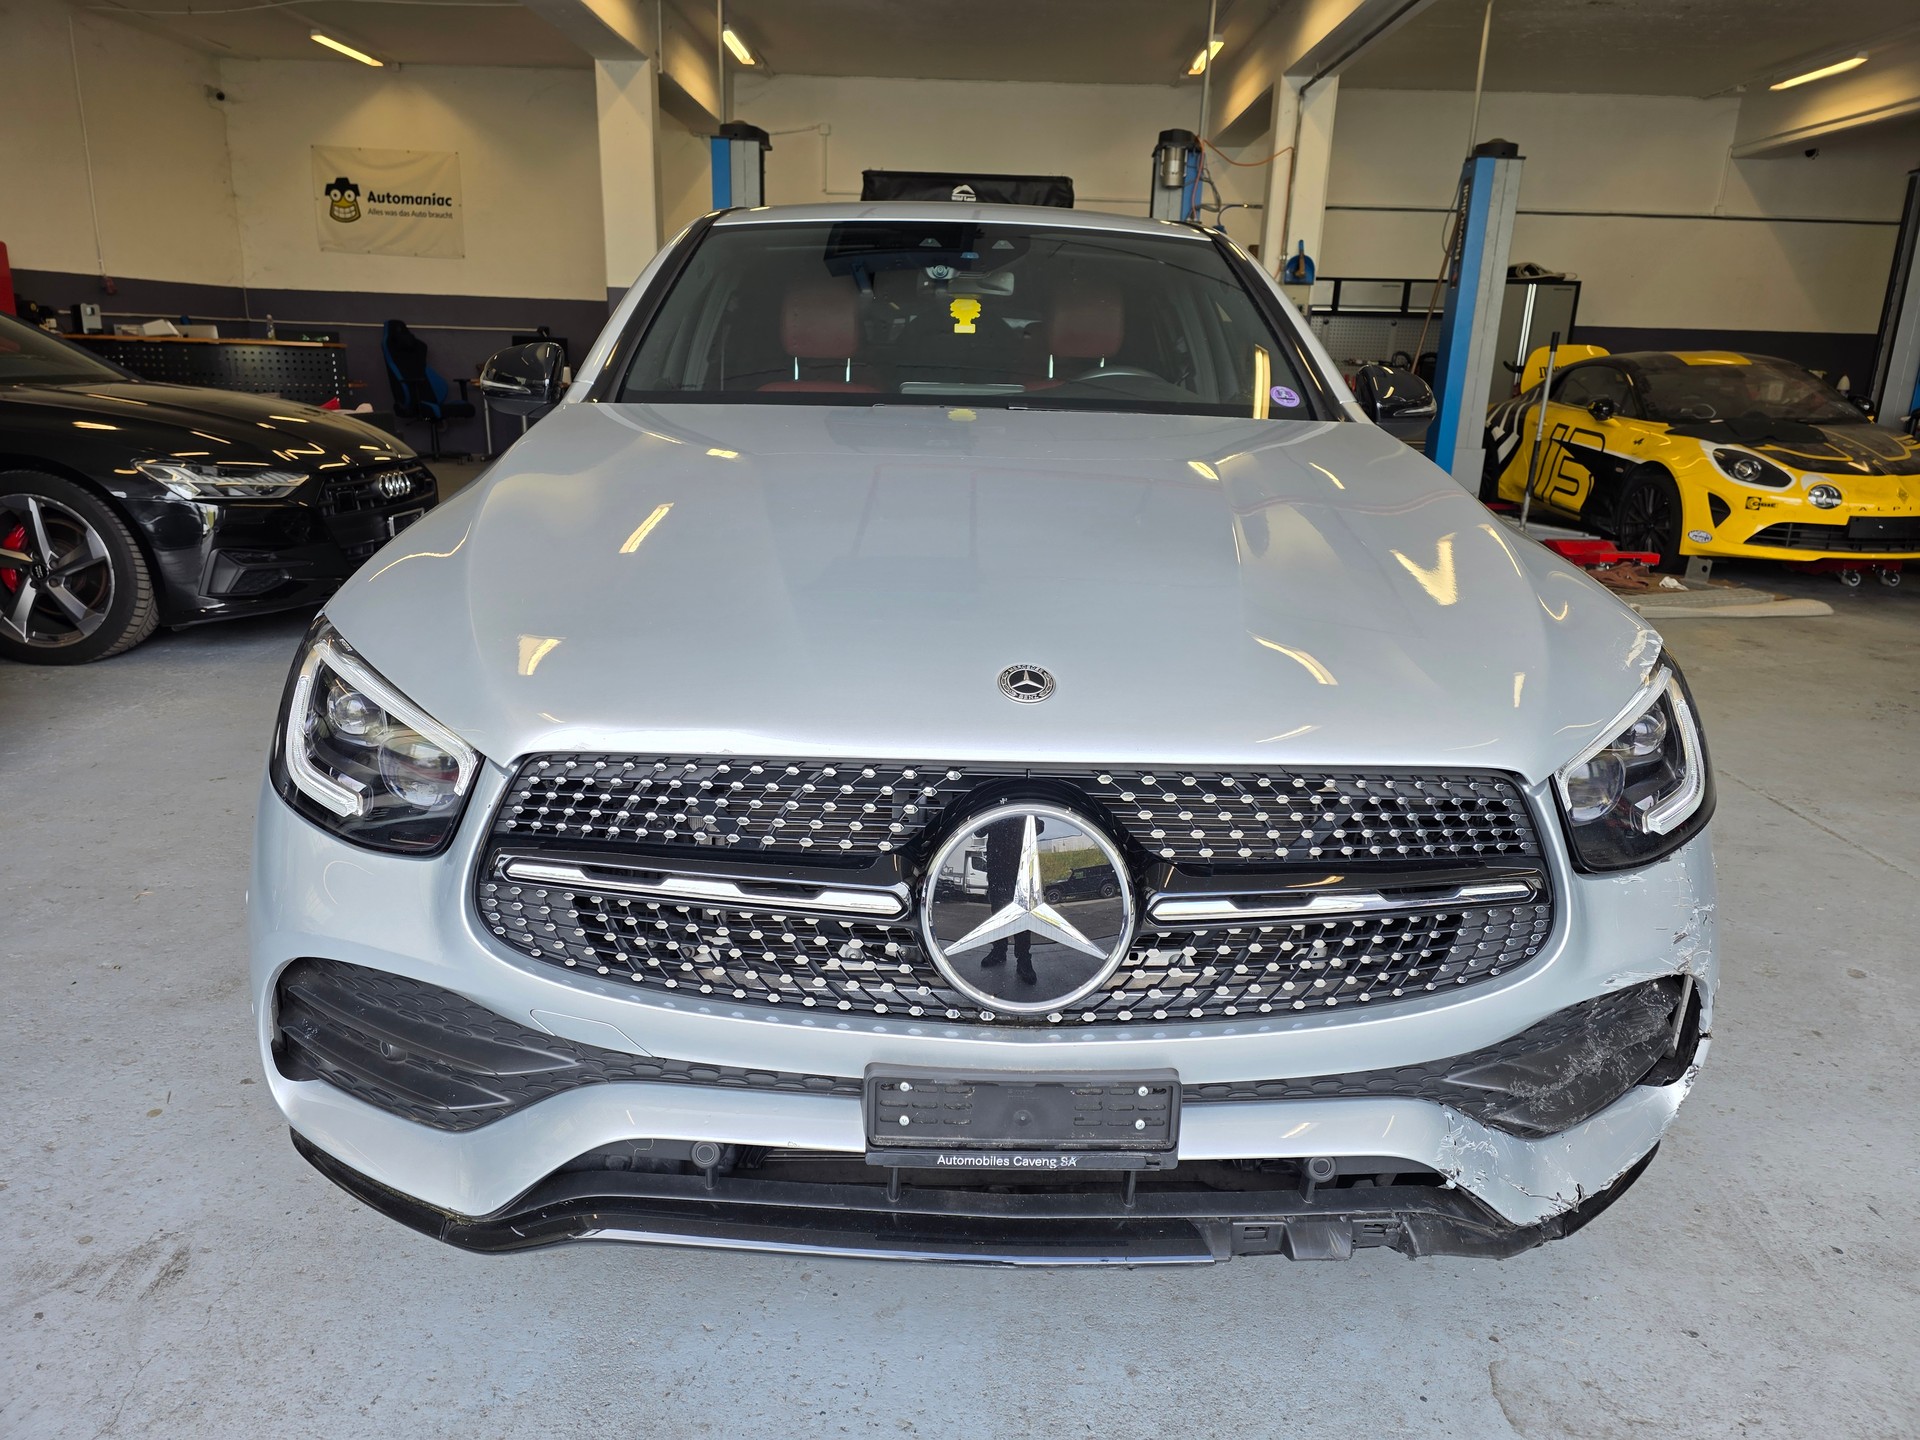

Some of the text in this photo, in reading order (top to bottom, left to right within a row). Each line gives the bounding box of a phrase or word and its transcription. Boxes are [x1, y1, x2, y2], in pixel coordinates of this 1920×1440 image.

[367, 190, 453, 207] Automaniac
[367, 208, 453, 219] Alles was das Auto braucht
[937, 1155, 1010, 1166] Automobiles
[1013, 1156, 1057, 1169] Caveng
